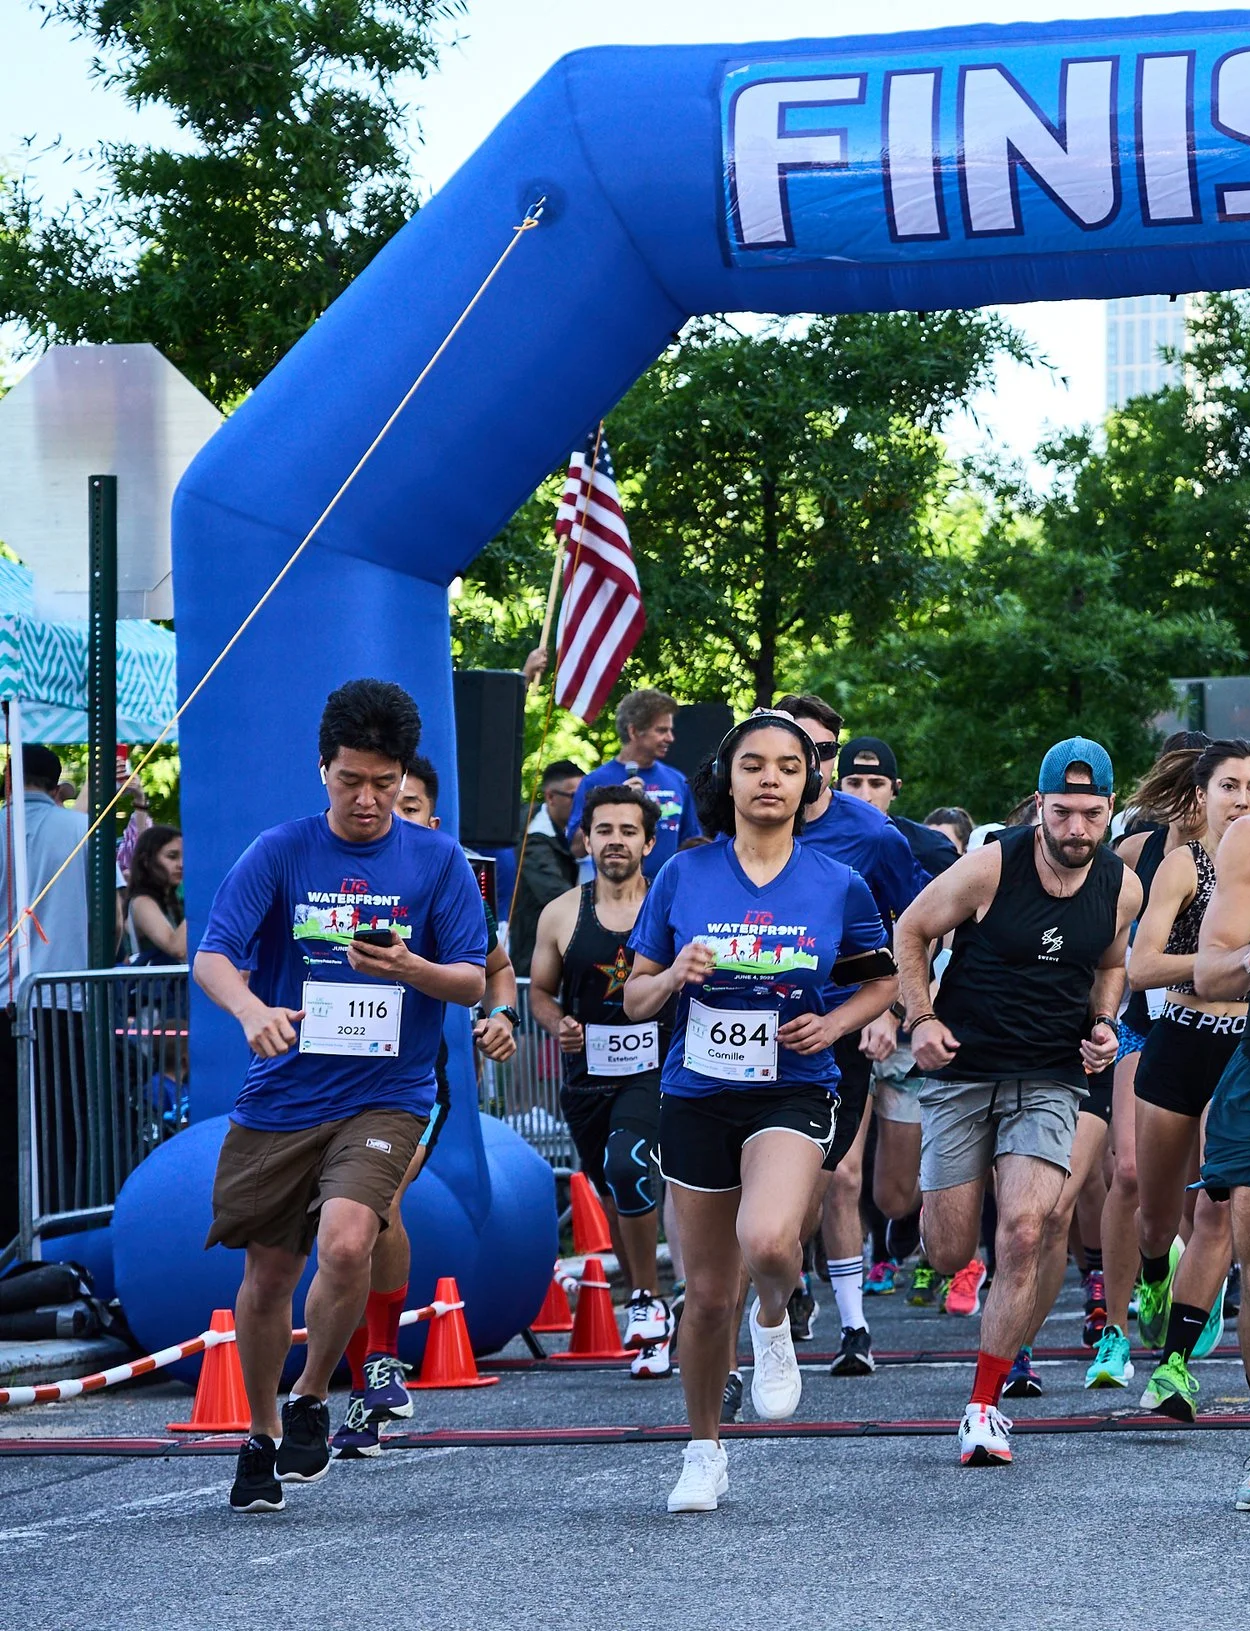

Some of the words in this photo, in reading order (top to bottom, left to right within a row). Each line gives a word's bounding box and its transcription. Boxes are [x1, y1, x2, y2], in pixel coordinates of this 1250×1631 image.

[341, 880, 369, 894] LIC
[307, 891, 401, 906] WATERFRONT
[390, 906, 409, 918] 5K
[743, 912, 774, 925] LIC
[707, 923, 807, 936] WATERFRONT
[797, 936, 817, 948] 5K
[348, 1000, 388, 1019] 1116
[1196, 1012, 1248, 1035] PRO
[337, 1025, 366, 1036] 2022
[710, 1021, 769, 1047] 684
[608, 1031, 654, 1053] 505
[607, 1055, 638, 1063] Esteban
[707, 1048, 745, 1061] Camille
